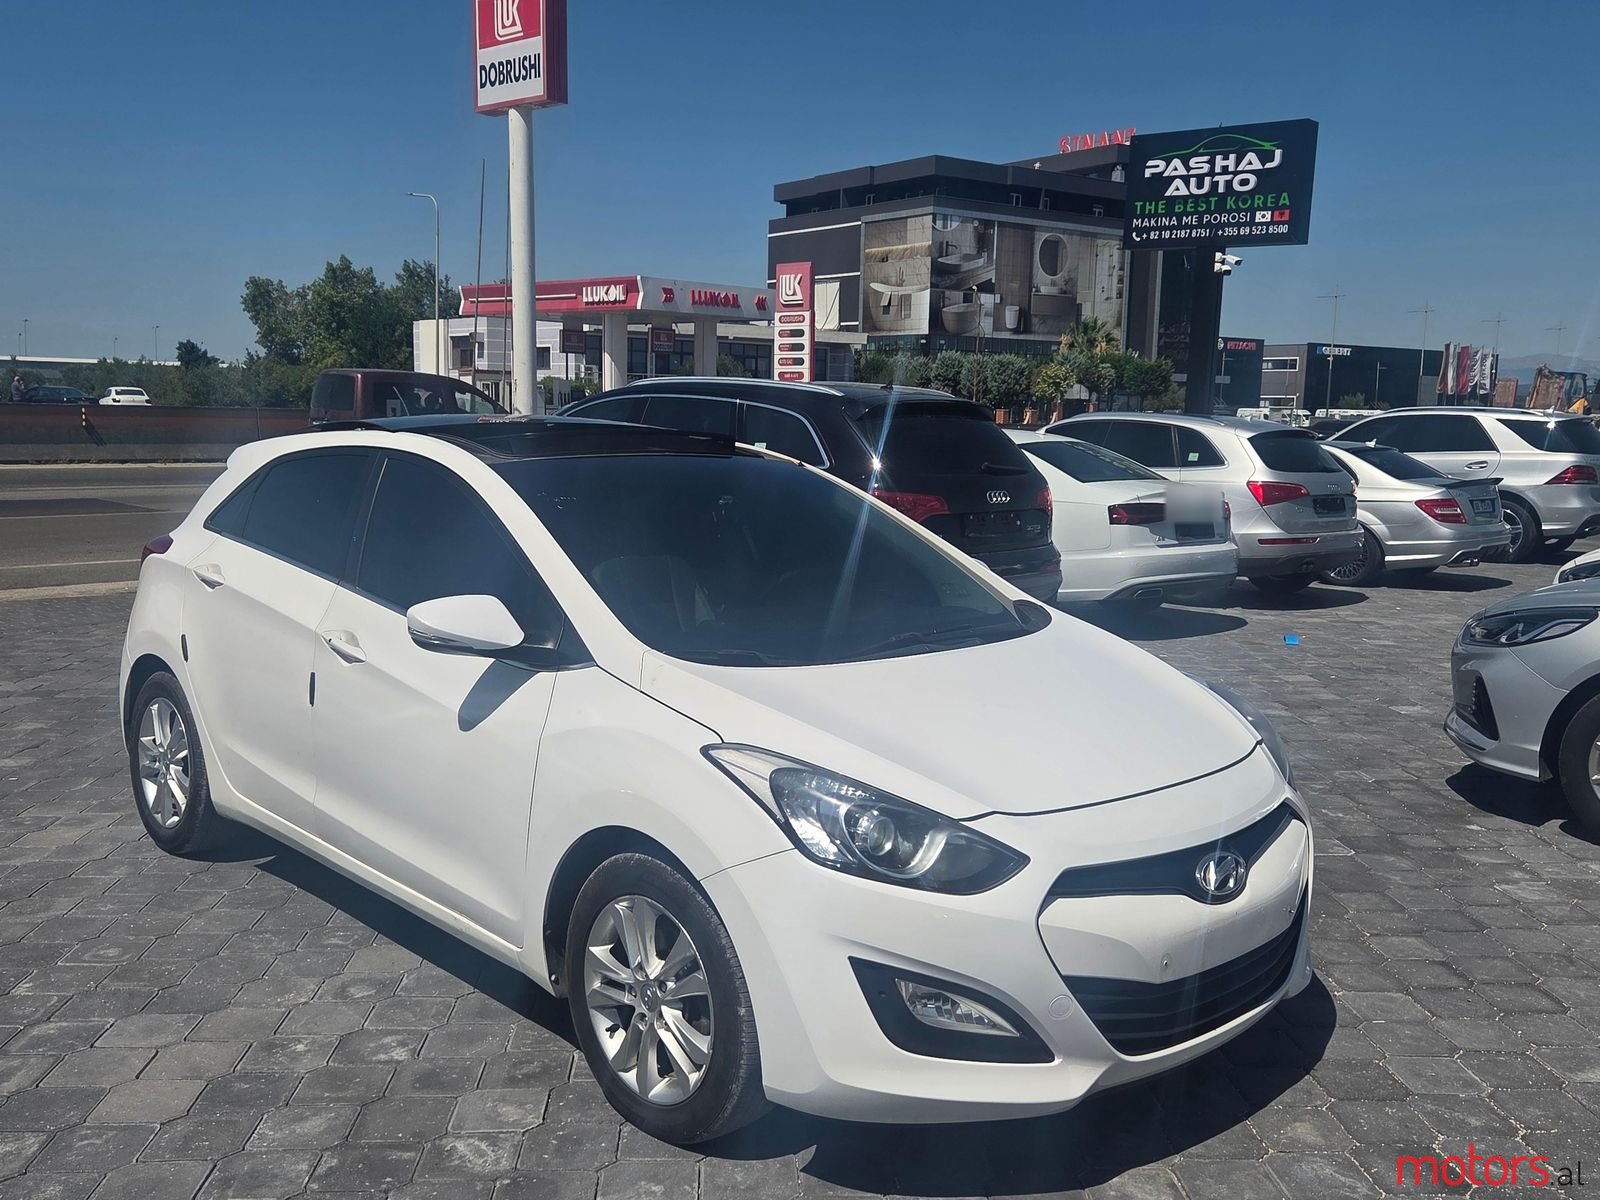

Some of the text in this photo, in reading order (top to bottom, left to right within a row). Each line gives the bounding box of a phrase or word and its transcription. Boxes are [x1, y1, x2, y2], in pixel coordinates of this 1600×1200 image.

[479, 53, 541, 89] DOBRUSHI
[1144, 148, 1284, 179] PASHAJ
[1163, 173, 1258, 197] AUTO
[1134, 192, 1290, 214] THE BEST KOREA
[1132, 212, 1250, 228] MAKINA ME POROSI
[1161, 230, 1170, 239] 10
[1171, 229, 1190, 239] 2187
[1191, 228, 1210, 238] 8751
[1217, 226, 1238, 236] +355
[1239, 225, 1250, 235] 69
[1251, 224, 1266, 235] 523
[1268, 224, 1289, 234] 8500
